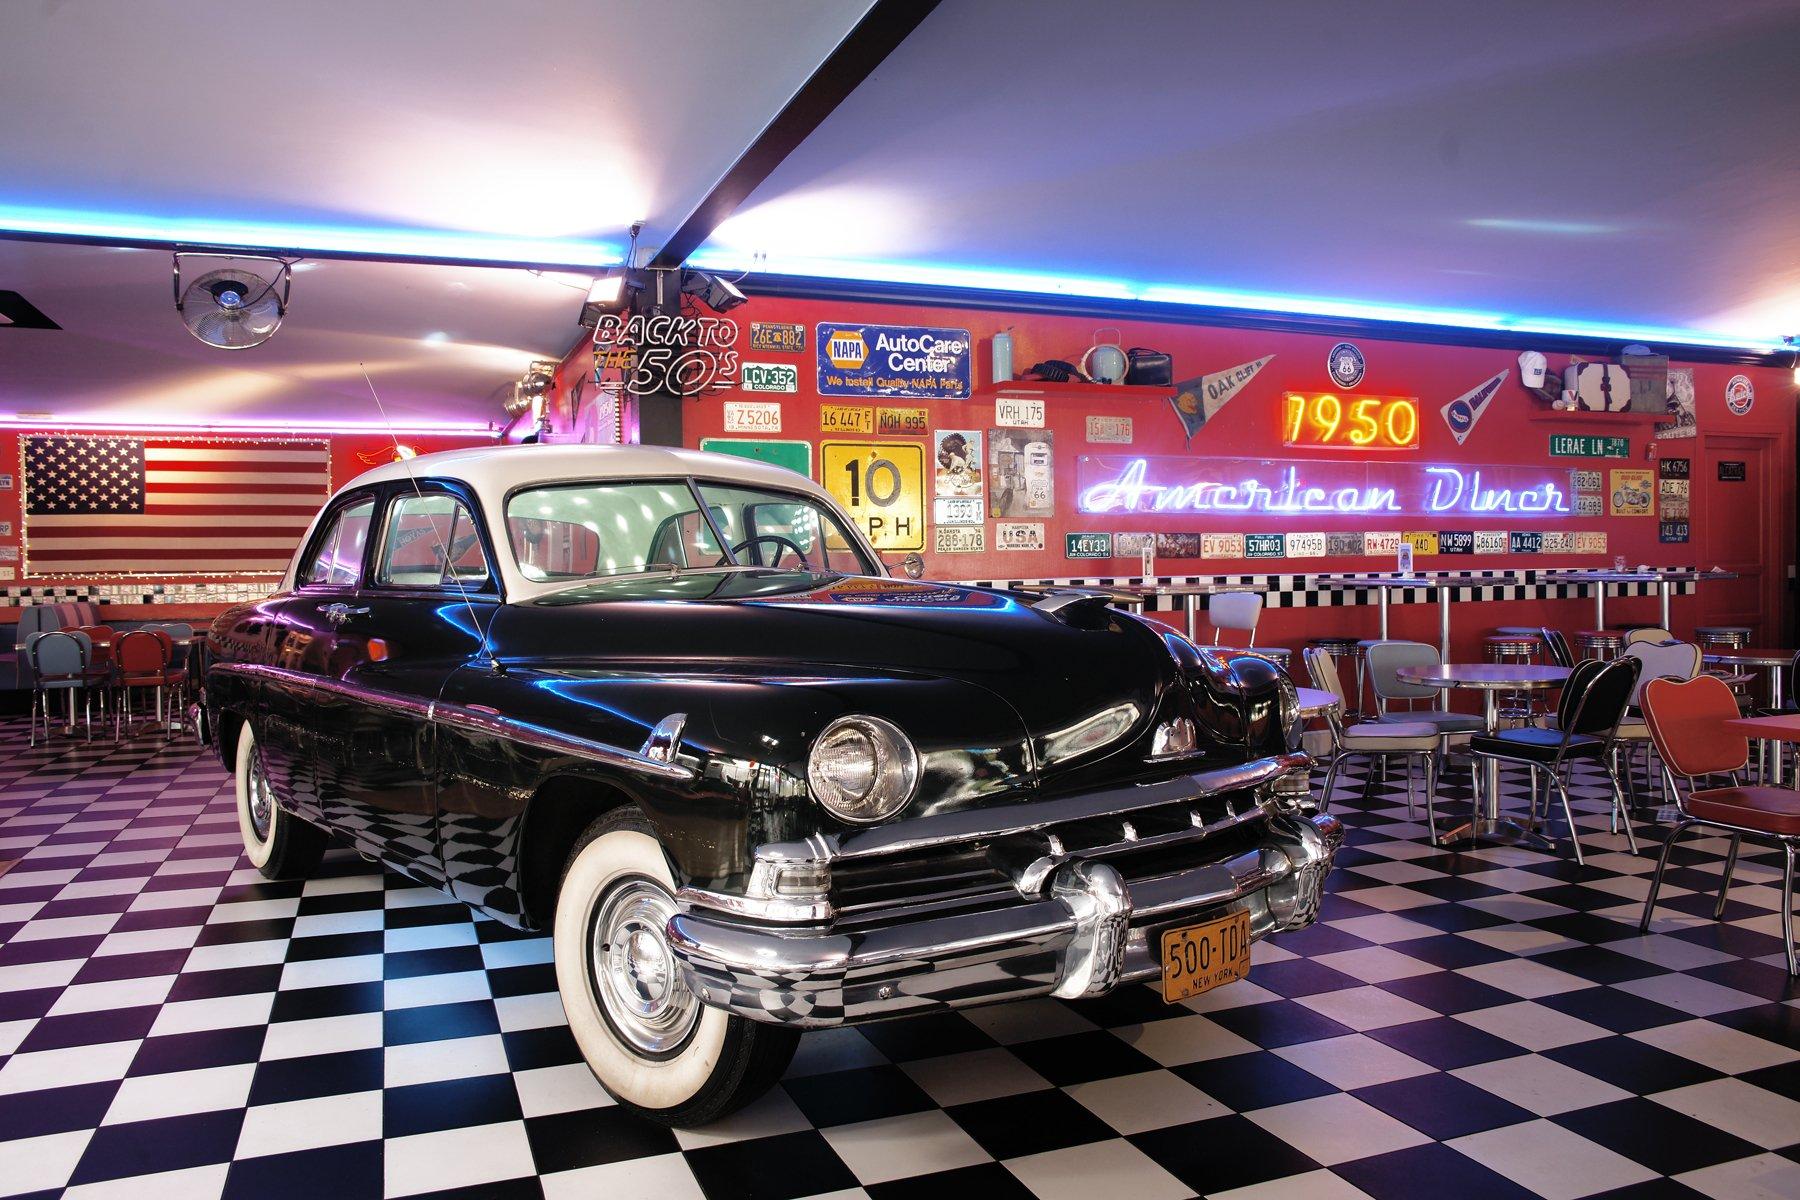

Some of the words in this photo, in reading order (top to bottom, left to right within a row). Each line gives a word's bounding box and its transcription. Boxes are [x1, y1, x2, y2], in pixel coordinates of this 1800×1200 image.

[593, 314, 696, 346] BACK
[697, 317, 738, 347] TO
[833, 341, 862, 359] NAPA
[876, 333, 963, 354] AutoCare
[593, 350, 637, 369] THE
[888, 353, 952, 372] Center
[627, 349, 738, 395] 50'S
[1343, 365, 1352, 373] 66
[826, 375, 843, 386] We
[845, 377, 874, 387] Install
[876, 378, 909, 389] Quality
[911, 379, 937, 389] NAPA
[940, 380, 963, 390] Parts
[1208, 375, 1235, 399] OAK
[999, 406, 1020, 418] VRH
[1024, 407, 1043, 420] 175
[1289, 394, 1416, 445] 1950
[905, 416, 926, 430] 995
[1555, 437, 1586, 455] LERAE
[1591, 438, 1603, 455] LN
[845, 459, 902, 508] 10
[1080, 459, 1402, 512] American
[1426, 466, 1570, 512] Diner
[1033, 490, 1046, 500] 66
[1070, 539, 1107, 553] 14EY33
[1203, 539, 1216, 553] EV
[1247, 539, 1281, 553] 57HR03
[1414, 539, 1429, 552] 440
[1440, 535, 1453, 547] NW
[1511, 536, 1521, 548] AA
[1523, 537, 1541, 549] 4412
[1170, 920, 1247, 979] 500-TDA
[1192, 975, 1211, 990] NEW
[1214, 966, 1233, 982] YORK
